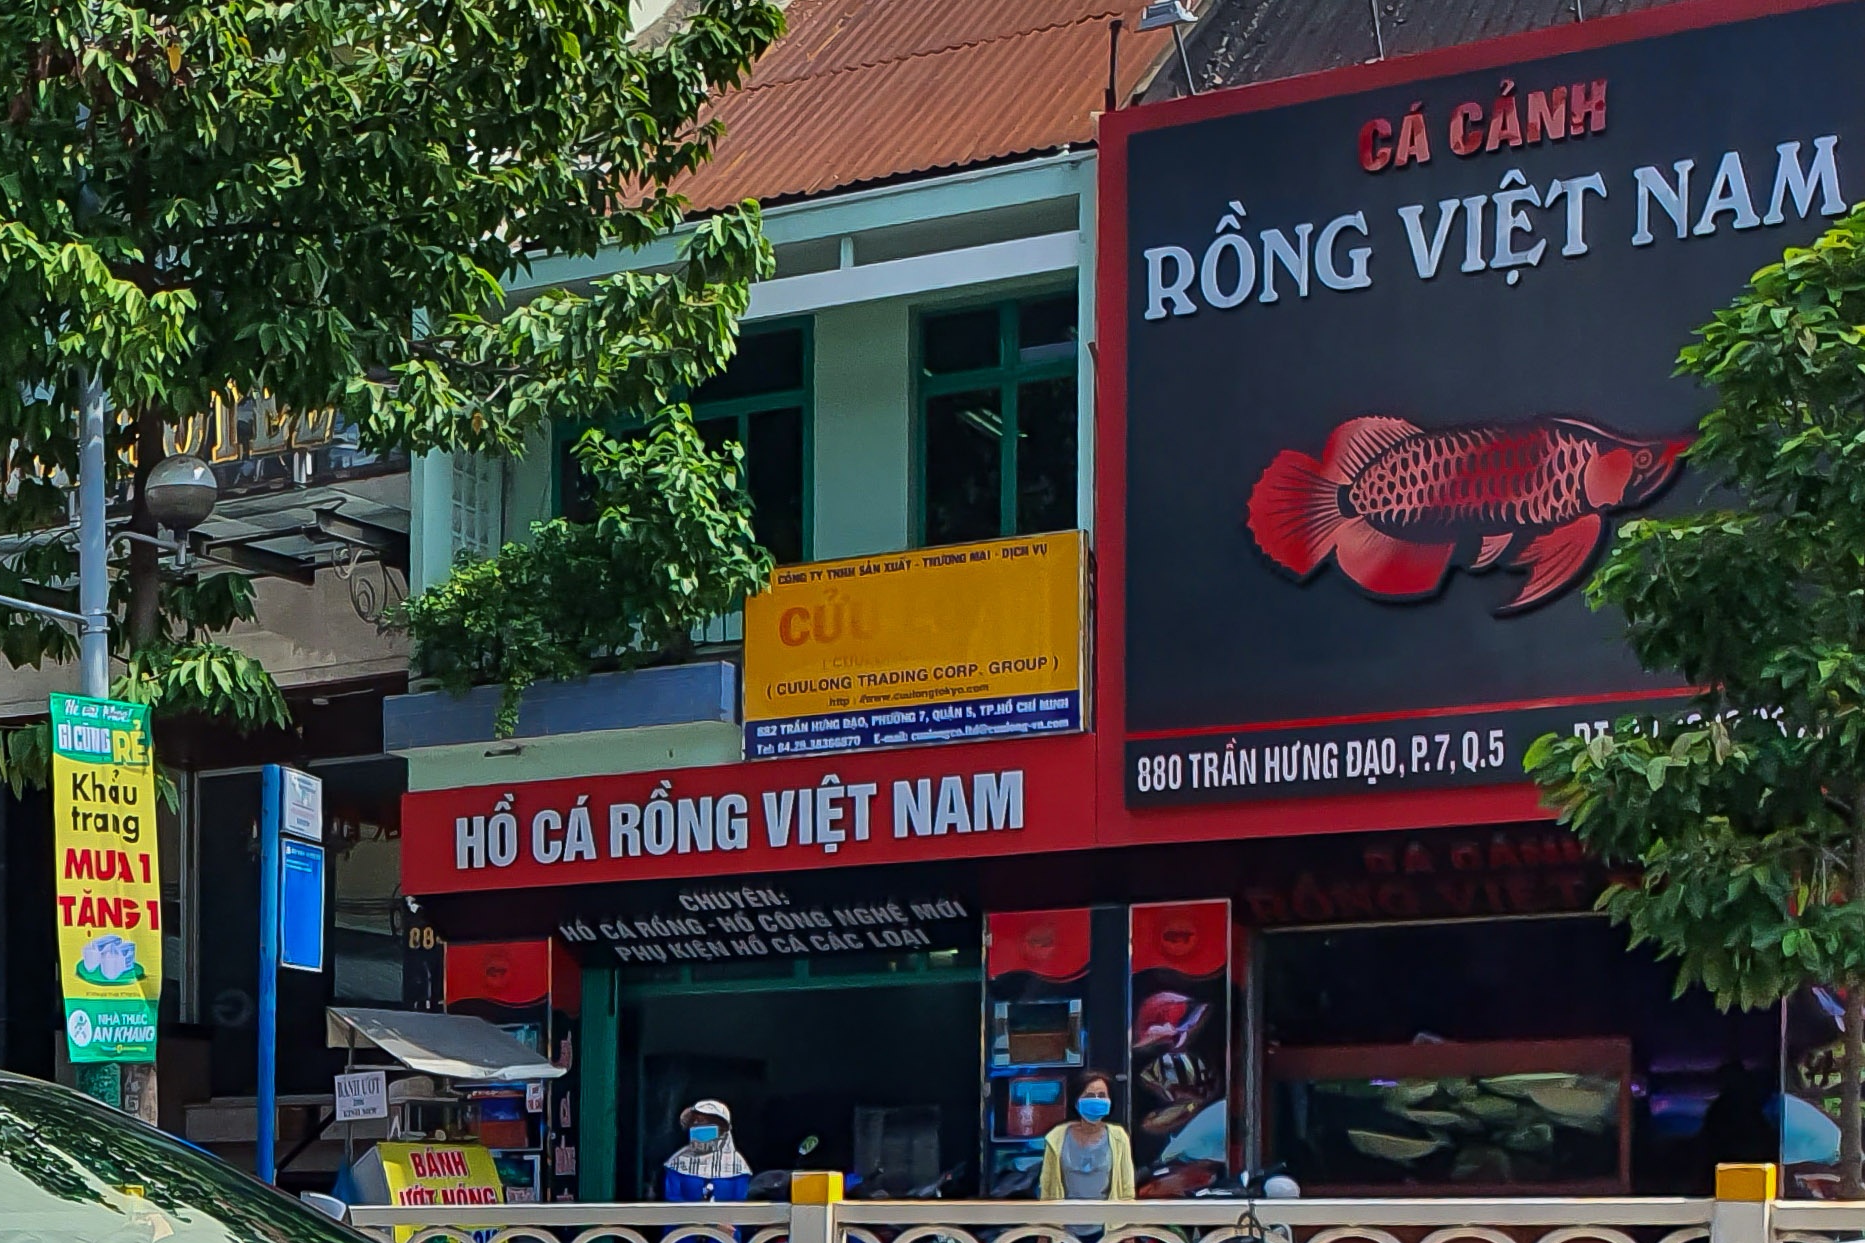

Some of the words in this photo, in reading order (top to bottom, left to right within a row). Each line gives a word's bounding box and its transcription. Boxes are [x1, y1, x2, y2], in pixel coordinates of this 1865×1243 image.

[1357, 103, 1432, 174] CÁ
[1449, 78, 1608, 158] CẢNH
[1143, 200, 1374, 321] RỒNG
[1397, 169, 1608, 286] VIỆT
[1631, 134, 1848, 248] NAM
[857, 668, 929, 688] TRADING
[989, 656, 1048, 675] GROUP
[112, 719, 146, 763] RẺ
[1136, 752, 1183, 792] 880
[1187, 736, 1258, 788] TRẦN
[1263, 740, 1339, 783] HƯNG
[1344, 737, 1405, 786] ĐẠO,
[1461, 729, 1505, 772] Q.5
[455, 792, 518, 870] HỒ
[531, 794, 598, 865] CÁ
[609, 778, 748, 858] RỒNG
[761, 773, 878, 853] VIỆT
[893, 769, 1025, 839] NAM
[64, 848, 135, 884] MUA
[139, 853, 151, 884] 1
[146, 900, 159, 930] 1
[678, 885, 791, 912] CHUYÊN:
[409, 1146, 469, 1179] BÁNH
